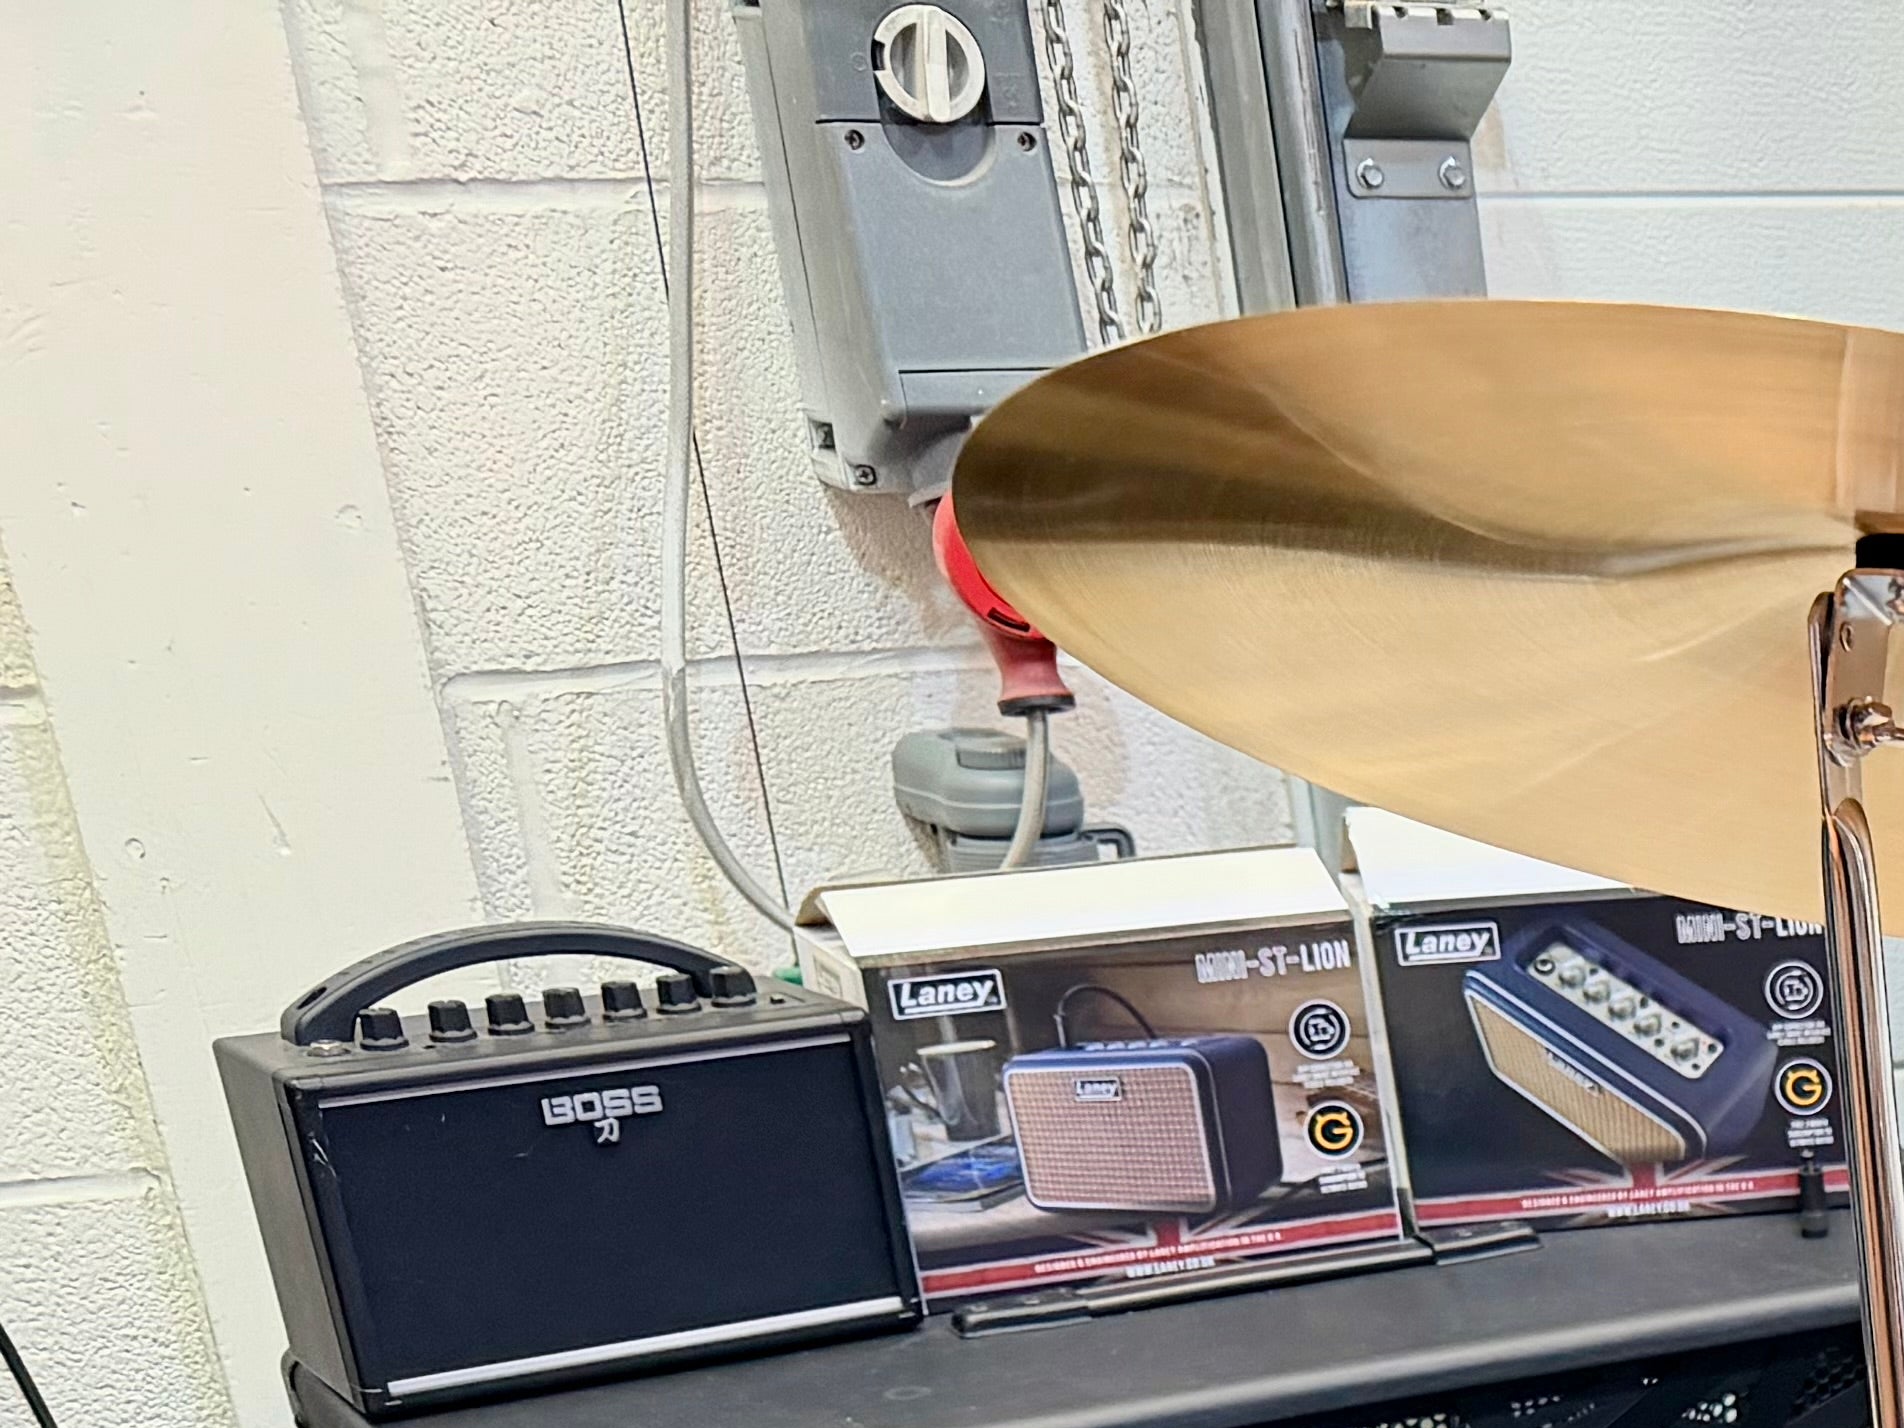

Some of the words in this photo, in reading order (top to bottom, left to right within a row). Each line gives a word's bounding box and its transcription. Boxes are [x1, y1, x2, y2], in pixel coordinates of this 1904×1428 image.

[1404, 929, 1490, 958] Laney
[899, 976, 996, 1010] Laney
[540, 1084, 663, 1126] BOSS
